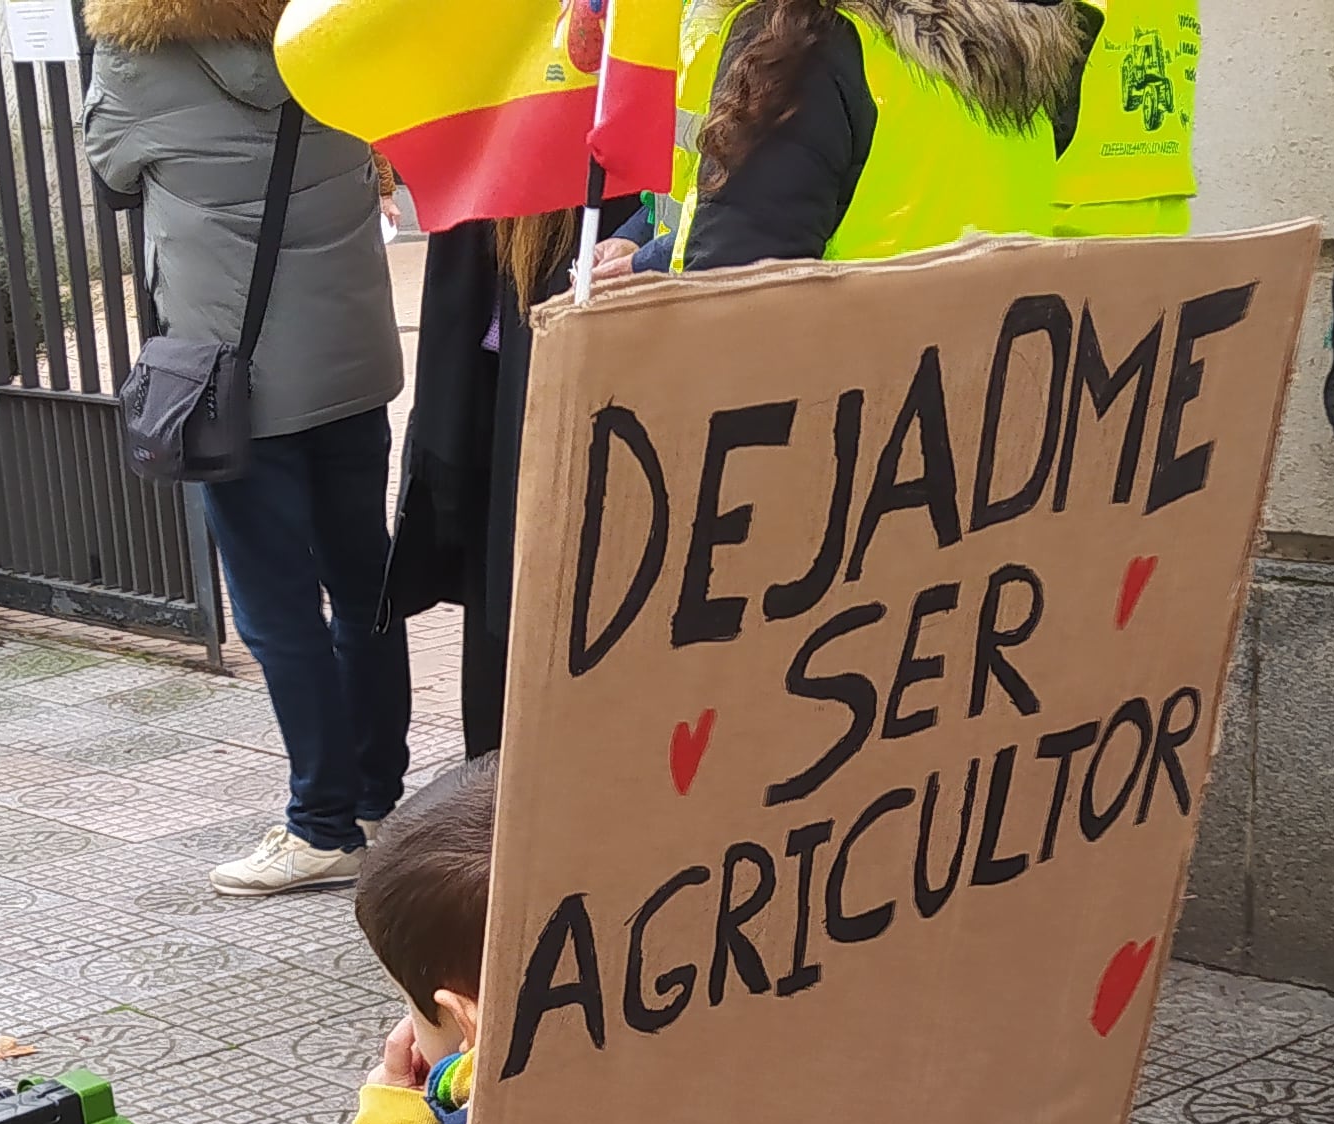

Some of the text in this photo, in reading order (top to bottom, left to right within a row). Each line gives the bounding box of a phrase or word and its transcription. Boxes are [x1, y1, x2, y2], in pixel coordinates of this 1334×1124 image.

[567, 281, 1261, 679] DEJADME
[763, 562, 1045, 807] SER
[499, 686, 1202, 1081] AGRICULTOR
